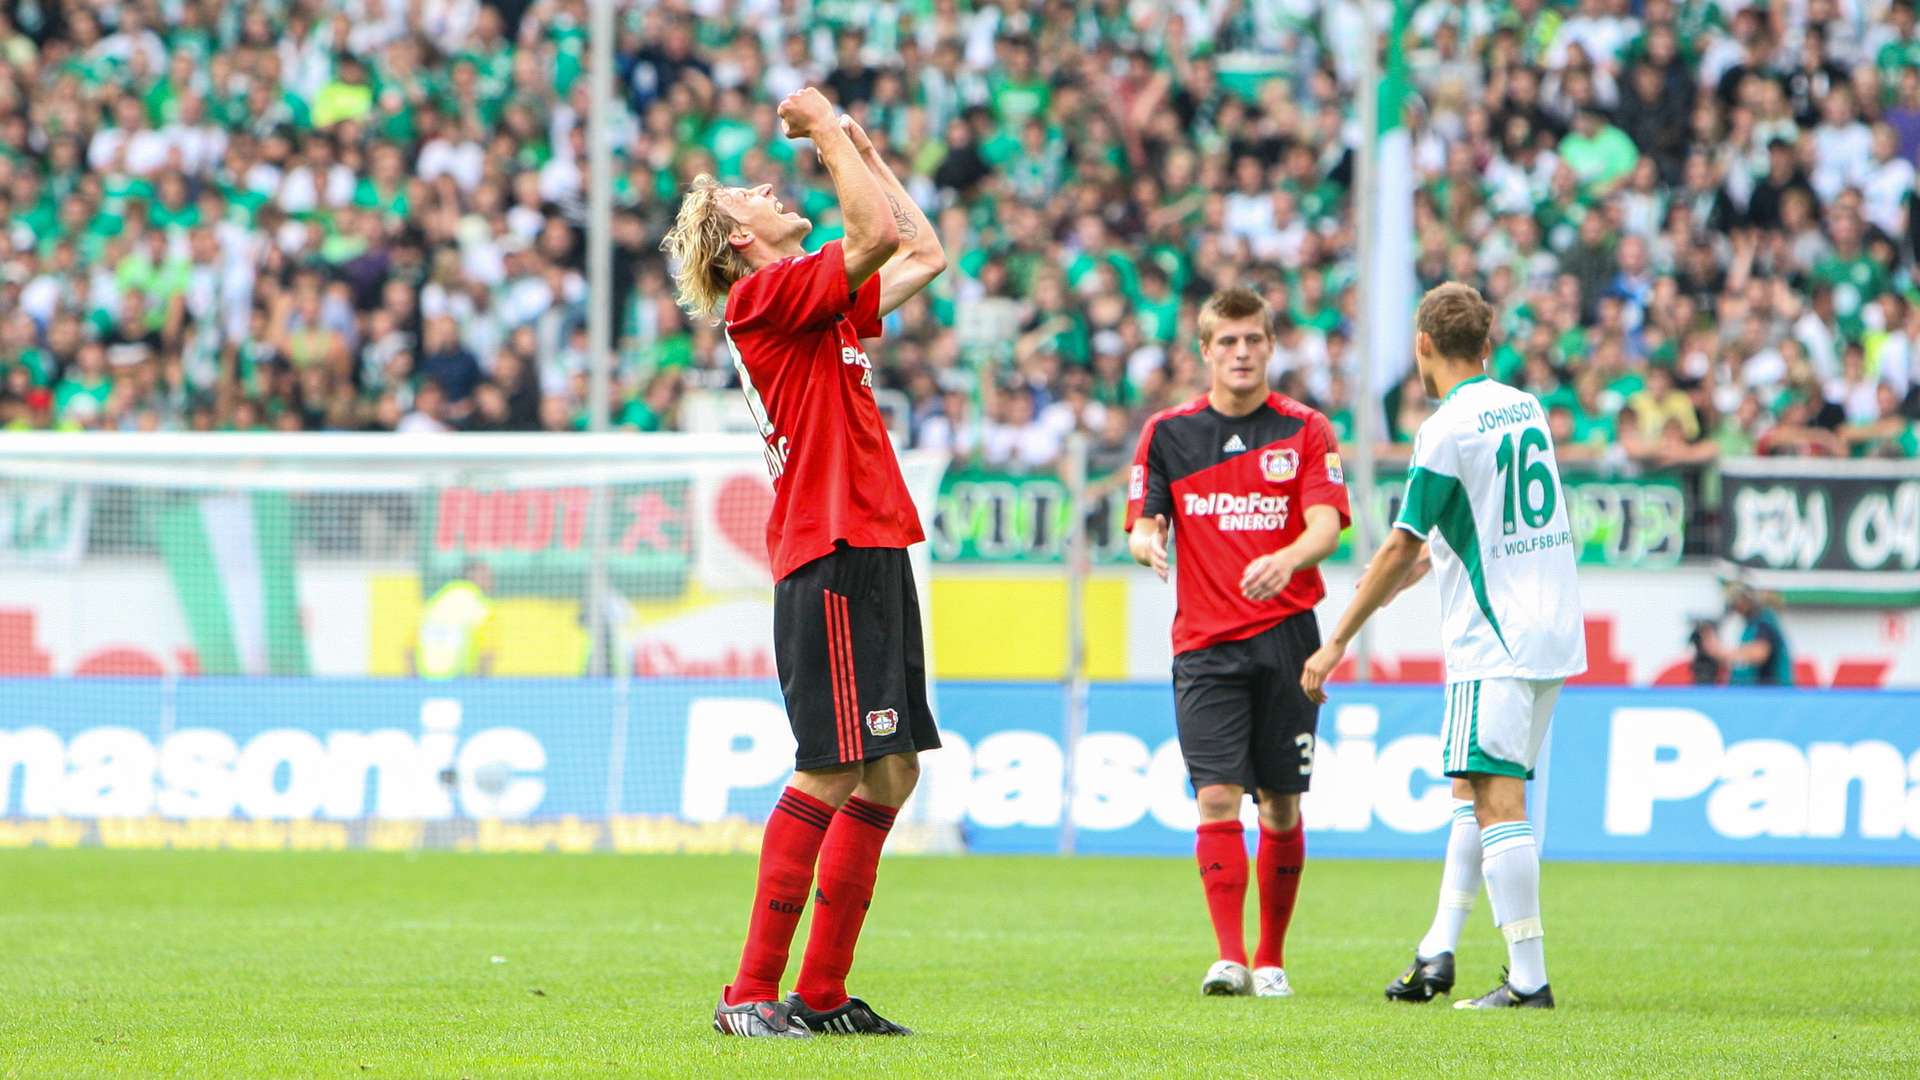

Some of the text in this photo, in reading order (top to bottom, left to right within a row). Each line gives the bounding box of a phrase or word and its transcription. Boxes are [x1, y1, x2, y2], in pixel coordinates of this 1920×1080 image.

[1183, 492, 1290, 515] TelDaFax
[1495, 427, 1557, 535] 16
[1218, 514, 1289, 532] ENERGY
[1603, 706, 1920, 840] Pan
